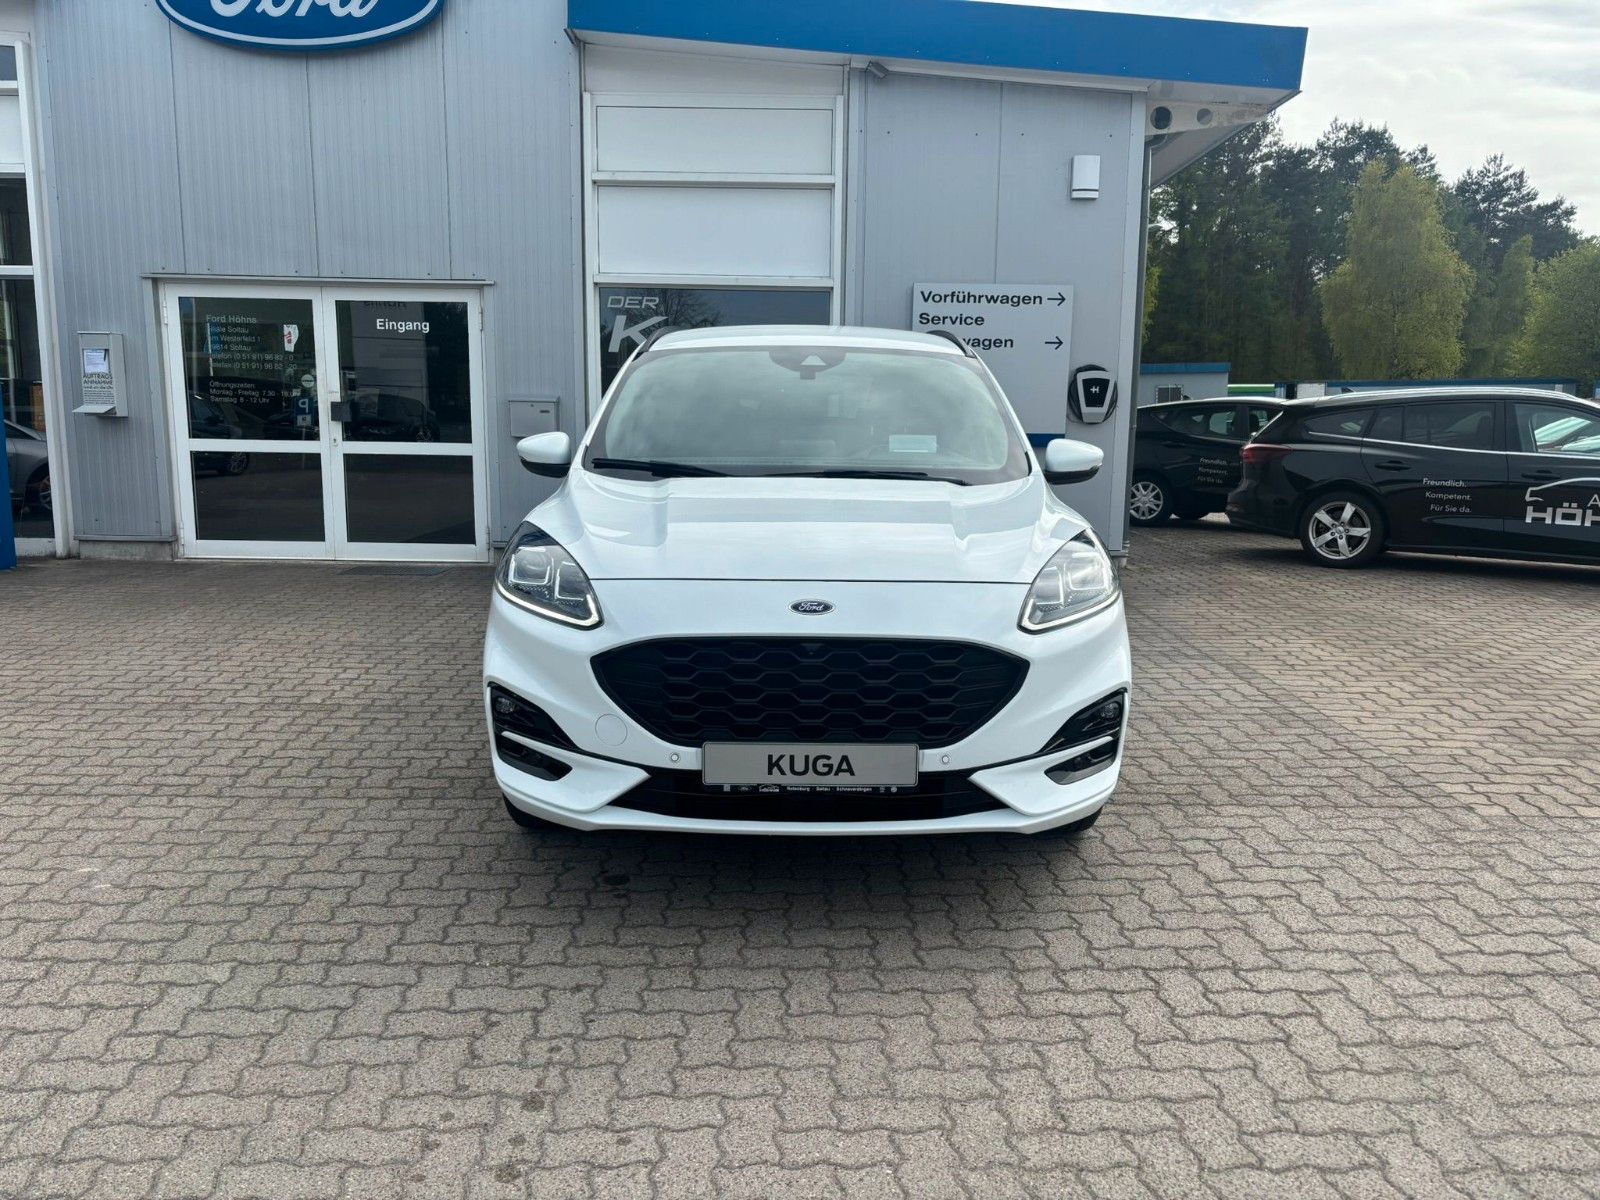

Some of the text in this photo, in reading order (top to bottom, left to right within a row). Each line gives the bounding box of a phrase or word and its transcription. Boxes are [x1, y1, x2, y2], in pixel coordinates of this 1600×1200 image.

[607, 295, 660, 309] DER
[920, 290, 1043, 307] Vorführwagen
[206, 314, 226, 323] Ford
[918, 312, 985, 326] Service
[376, 318, 430, 334] Eingang
[1422, 477, 1467, 488] Freundlich.
[1425, 491, 1472, 501] Kompetent.
[798, 602, 824, 611] Ford
[767, 754, 856, 776] KUGA
